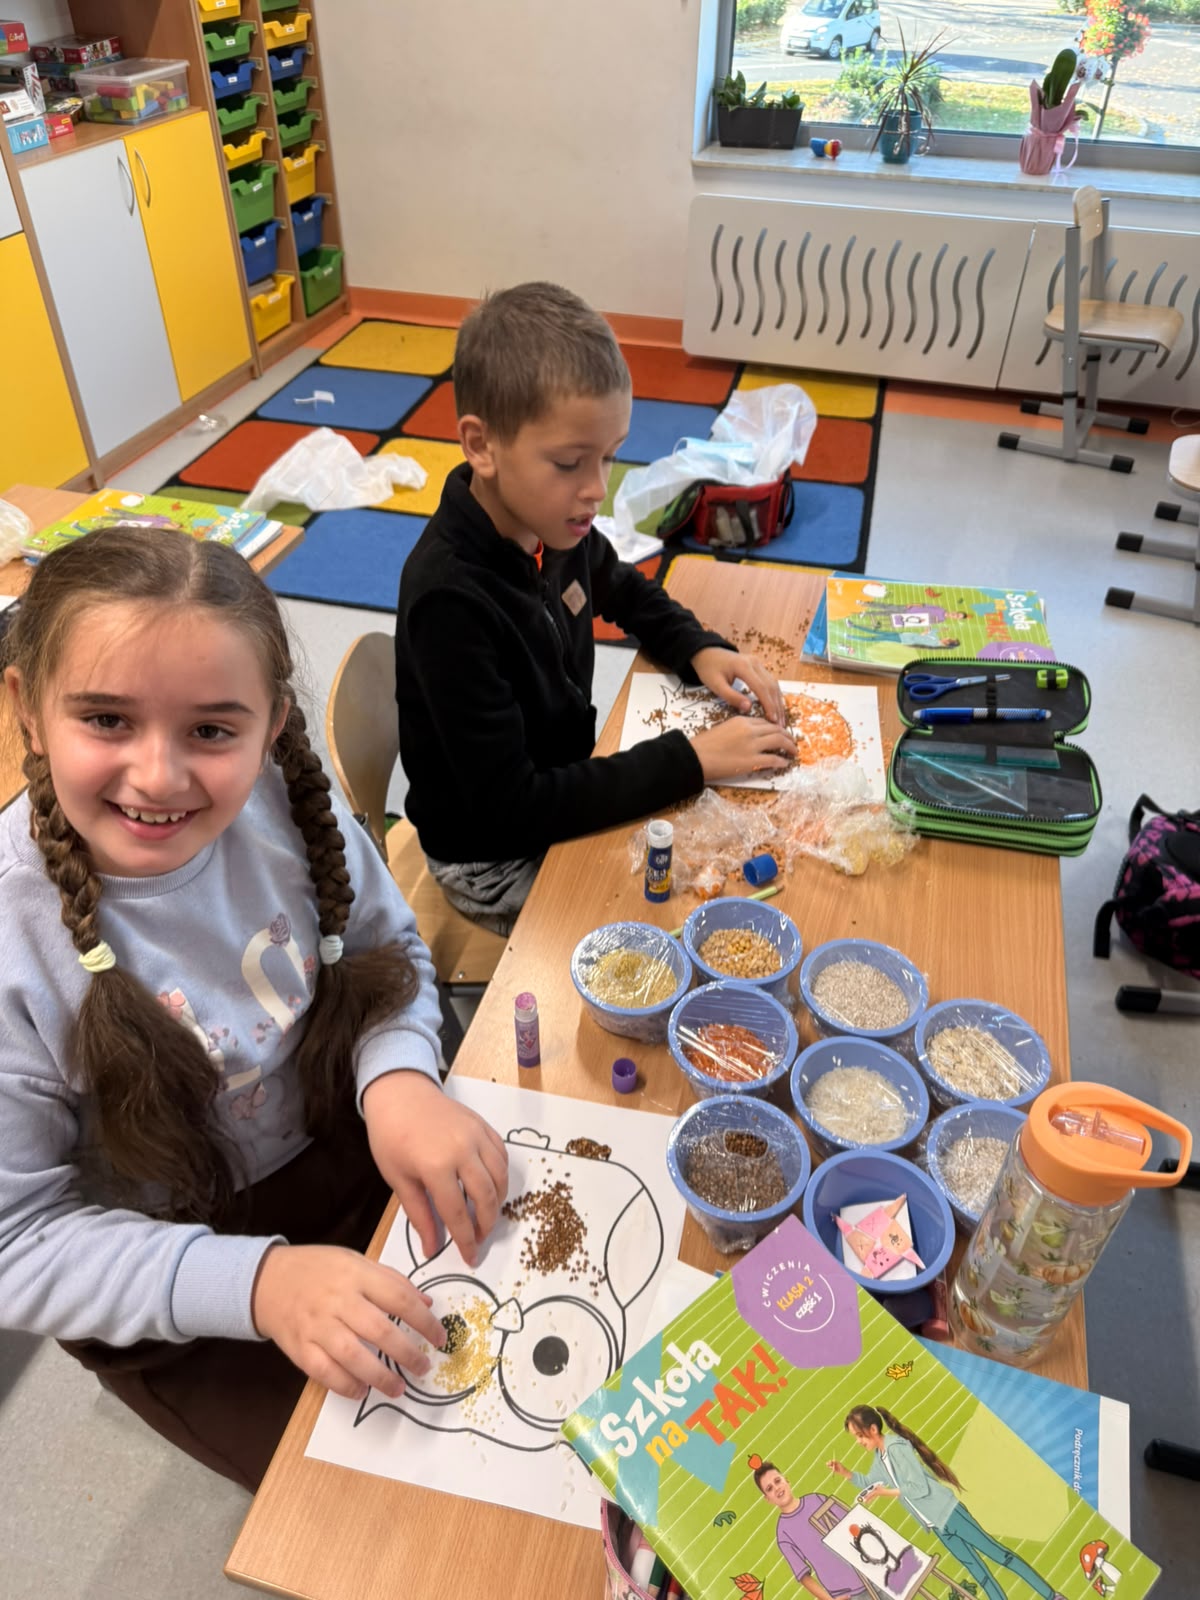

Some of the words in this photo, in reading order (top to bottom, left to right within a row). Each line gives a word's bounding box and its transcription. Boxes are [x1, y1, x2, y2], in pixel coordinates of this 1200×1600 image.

[776, 1282, 807, 1311] KLASA
[803, 1275, 814, 1287] 2
[813, 1291, 823, 1302] 1
[600, 1339, 722, 1458] Szkoła
[645, 1419, 689, 1466] na
[684, 1343, 788, 1446] TAK!
[1072, 1428, 1083, 1480] Podręcznik
